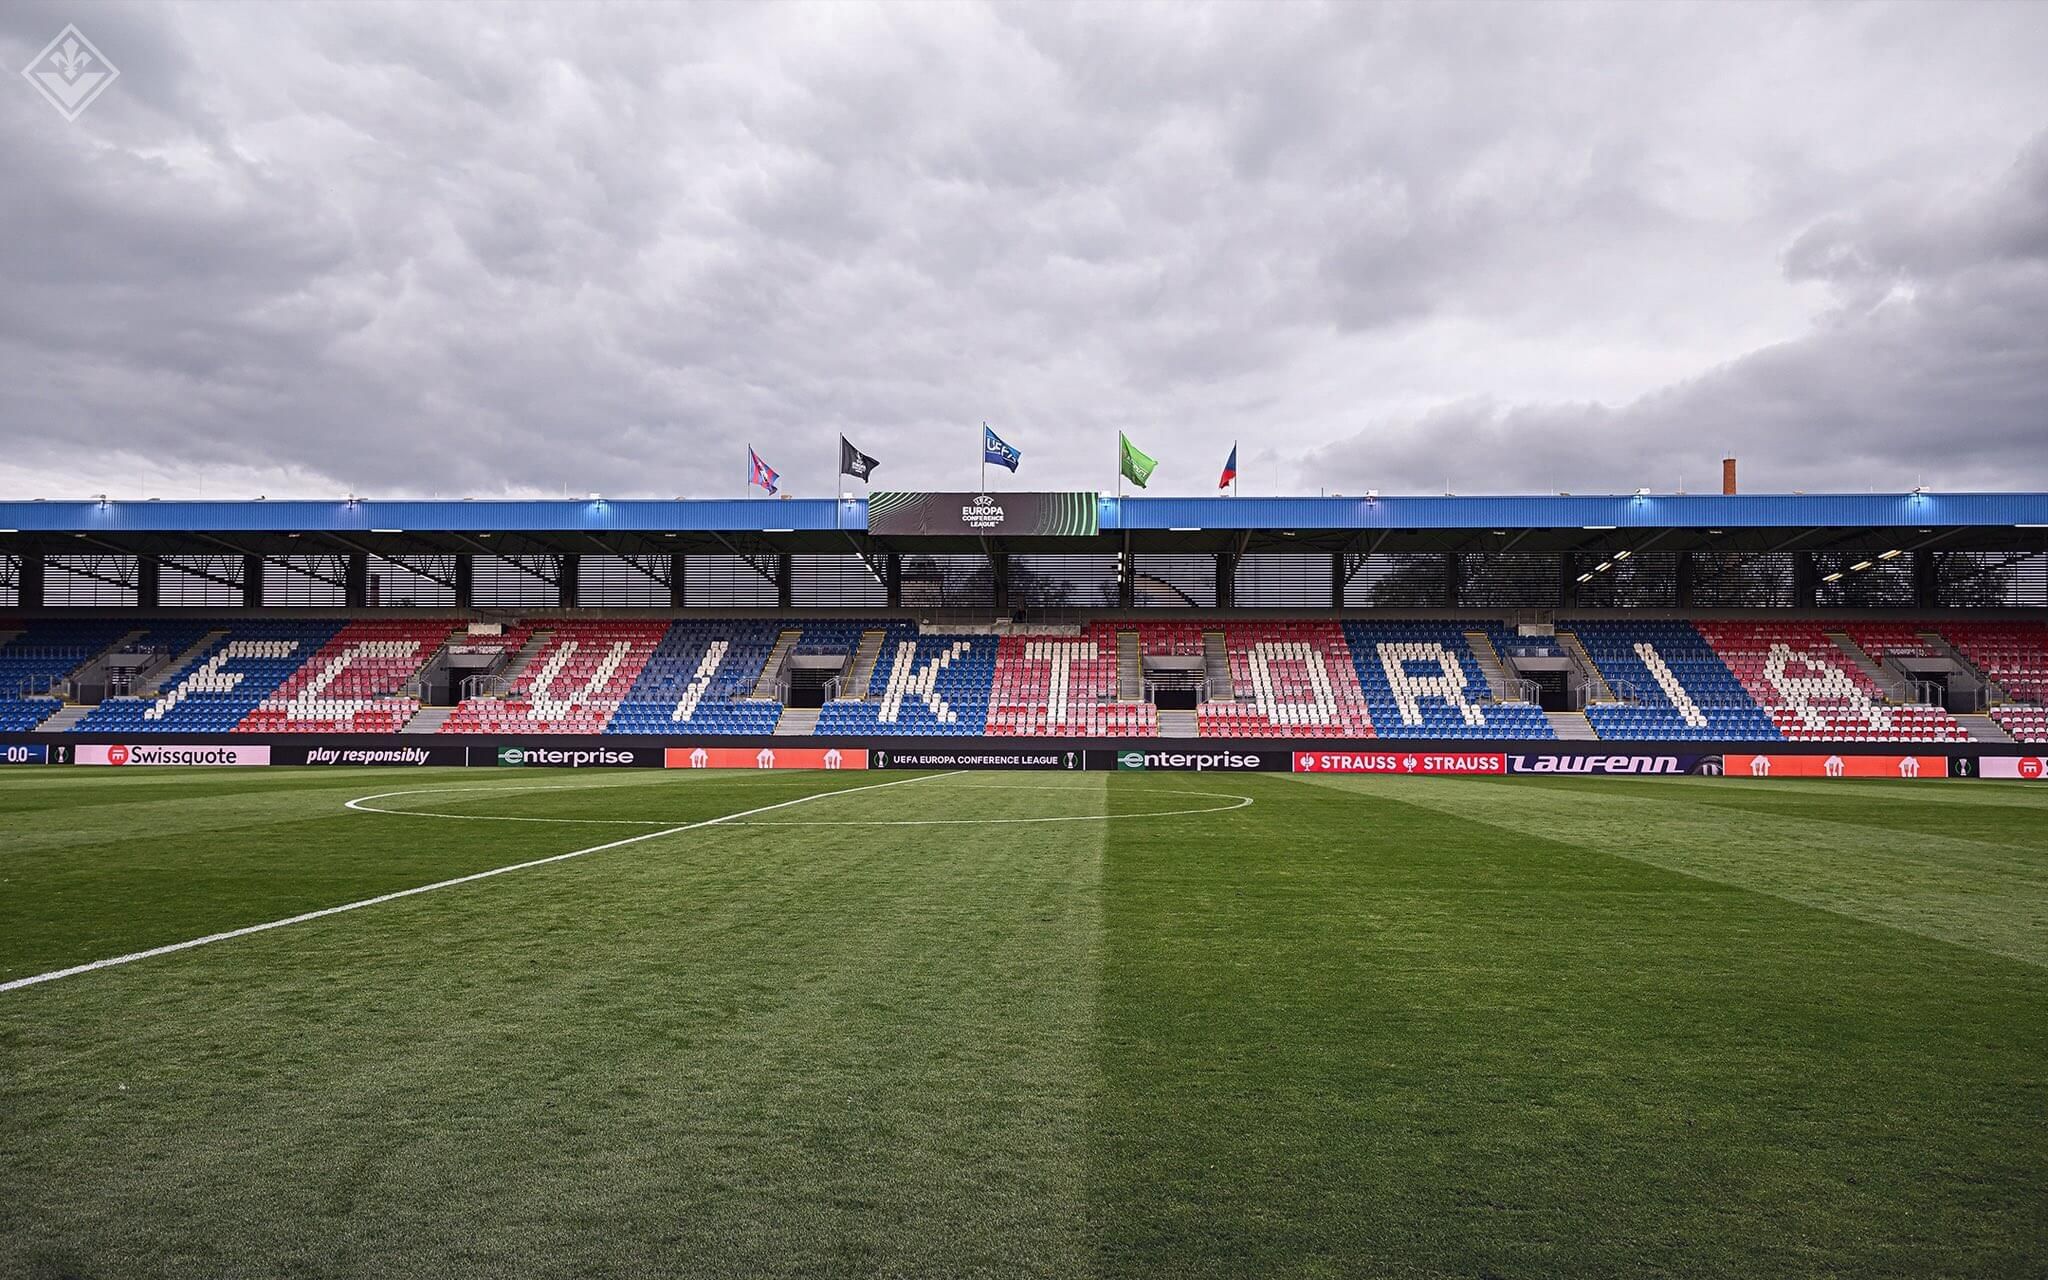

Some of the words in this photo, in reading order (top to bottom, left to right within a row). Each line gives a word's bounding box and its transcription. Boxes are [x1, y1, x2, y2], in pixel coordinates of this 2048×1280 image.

[962, 506, 1004, 515] EUROPA
[131, 746, 237, 765] Swissquote
[306, 747, 340, 764] play
[342, 747, 430, 765] responsibly
[499, 747, 634, 767] enterprise
[893, 755, 918, 764] UEFA
[919, 755, 956, 765] EUROPA
[957, 755, 1020, 765] CONFERENCE
[1021, 756, 1058, 765] LEAGUE
[1118, 750, 1260, 771] enterprise
[1321, 755, 1397, 770] STRAUSS
[1423, 756, 1499, 771] STRAUSS
